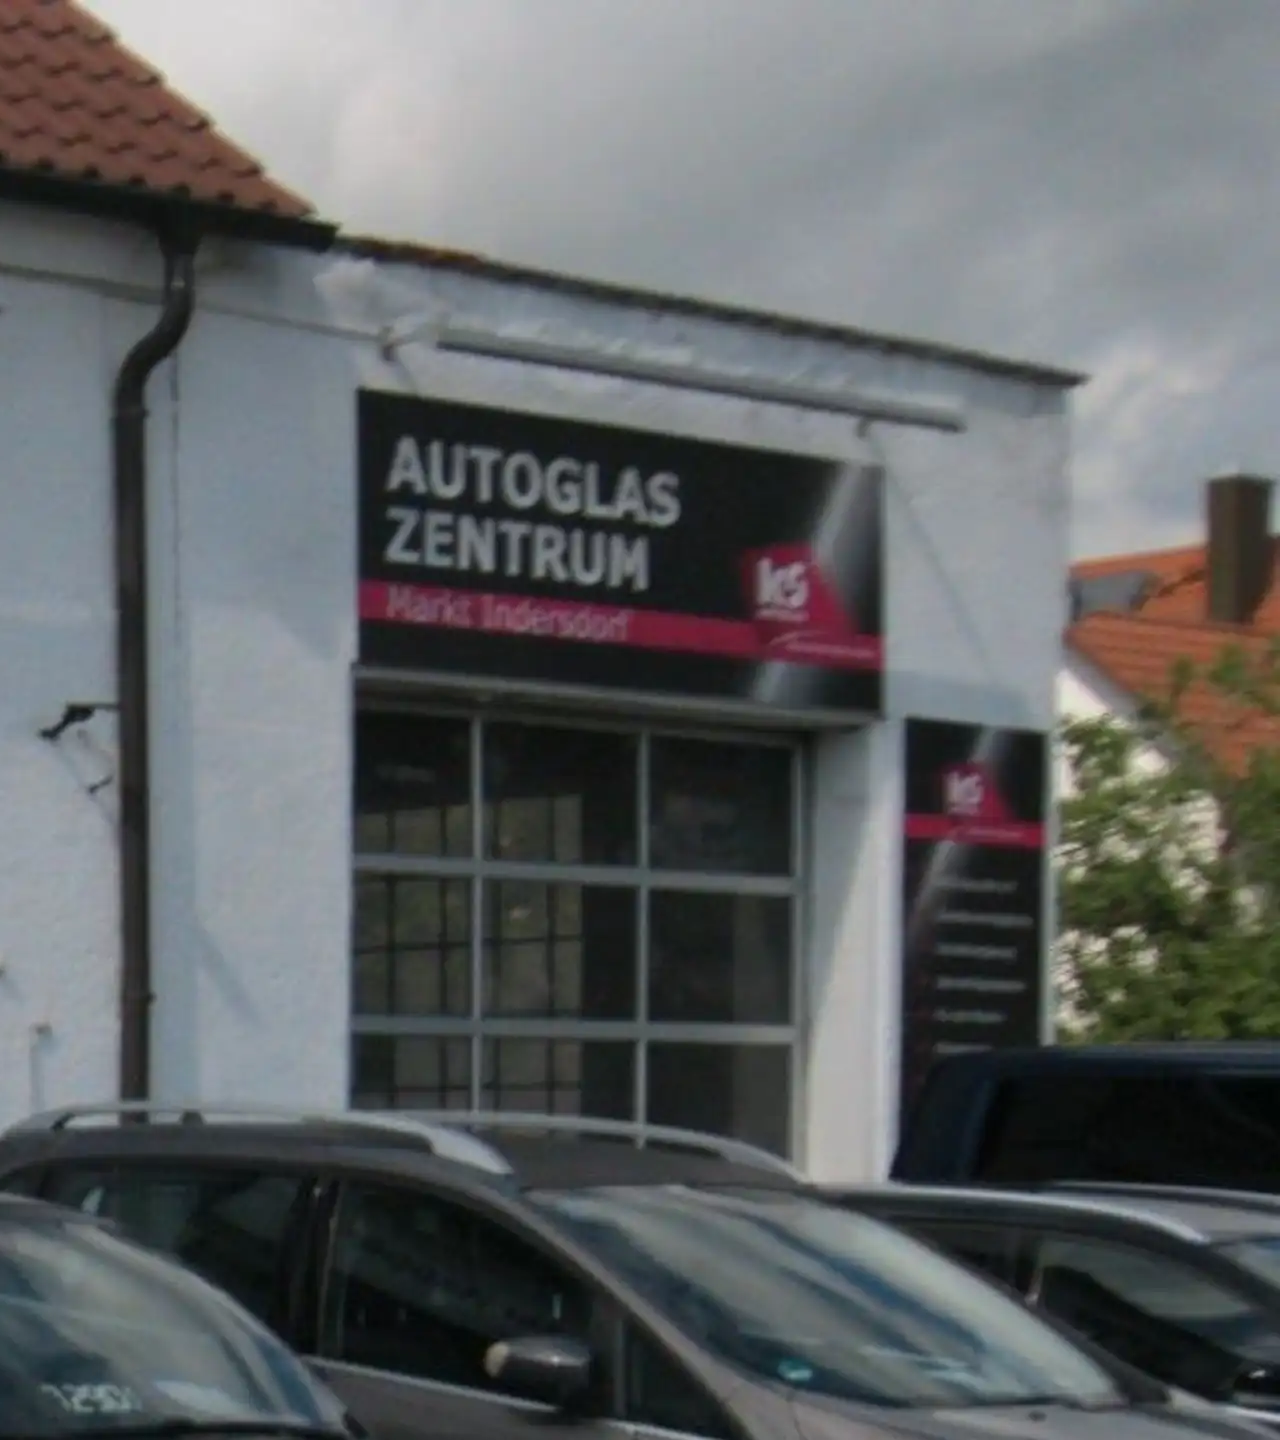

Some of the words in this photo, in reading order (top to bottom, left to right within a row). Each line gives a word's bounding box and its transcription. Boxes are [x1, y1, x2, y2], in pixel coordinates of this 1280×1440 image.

[385, 435, 681, 528] AUTOGLAS
[384, 506, 650, 591] ZENTRUM
[479, 593, 630, 642] Indersdorf
